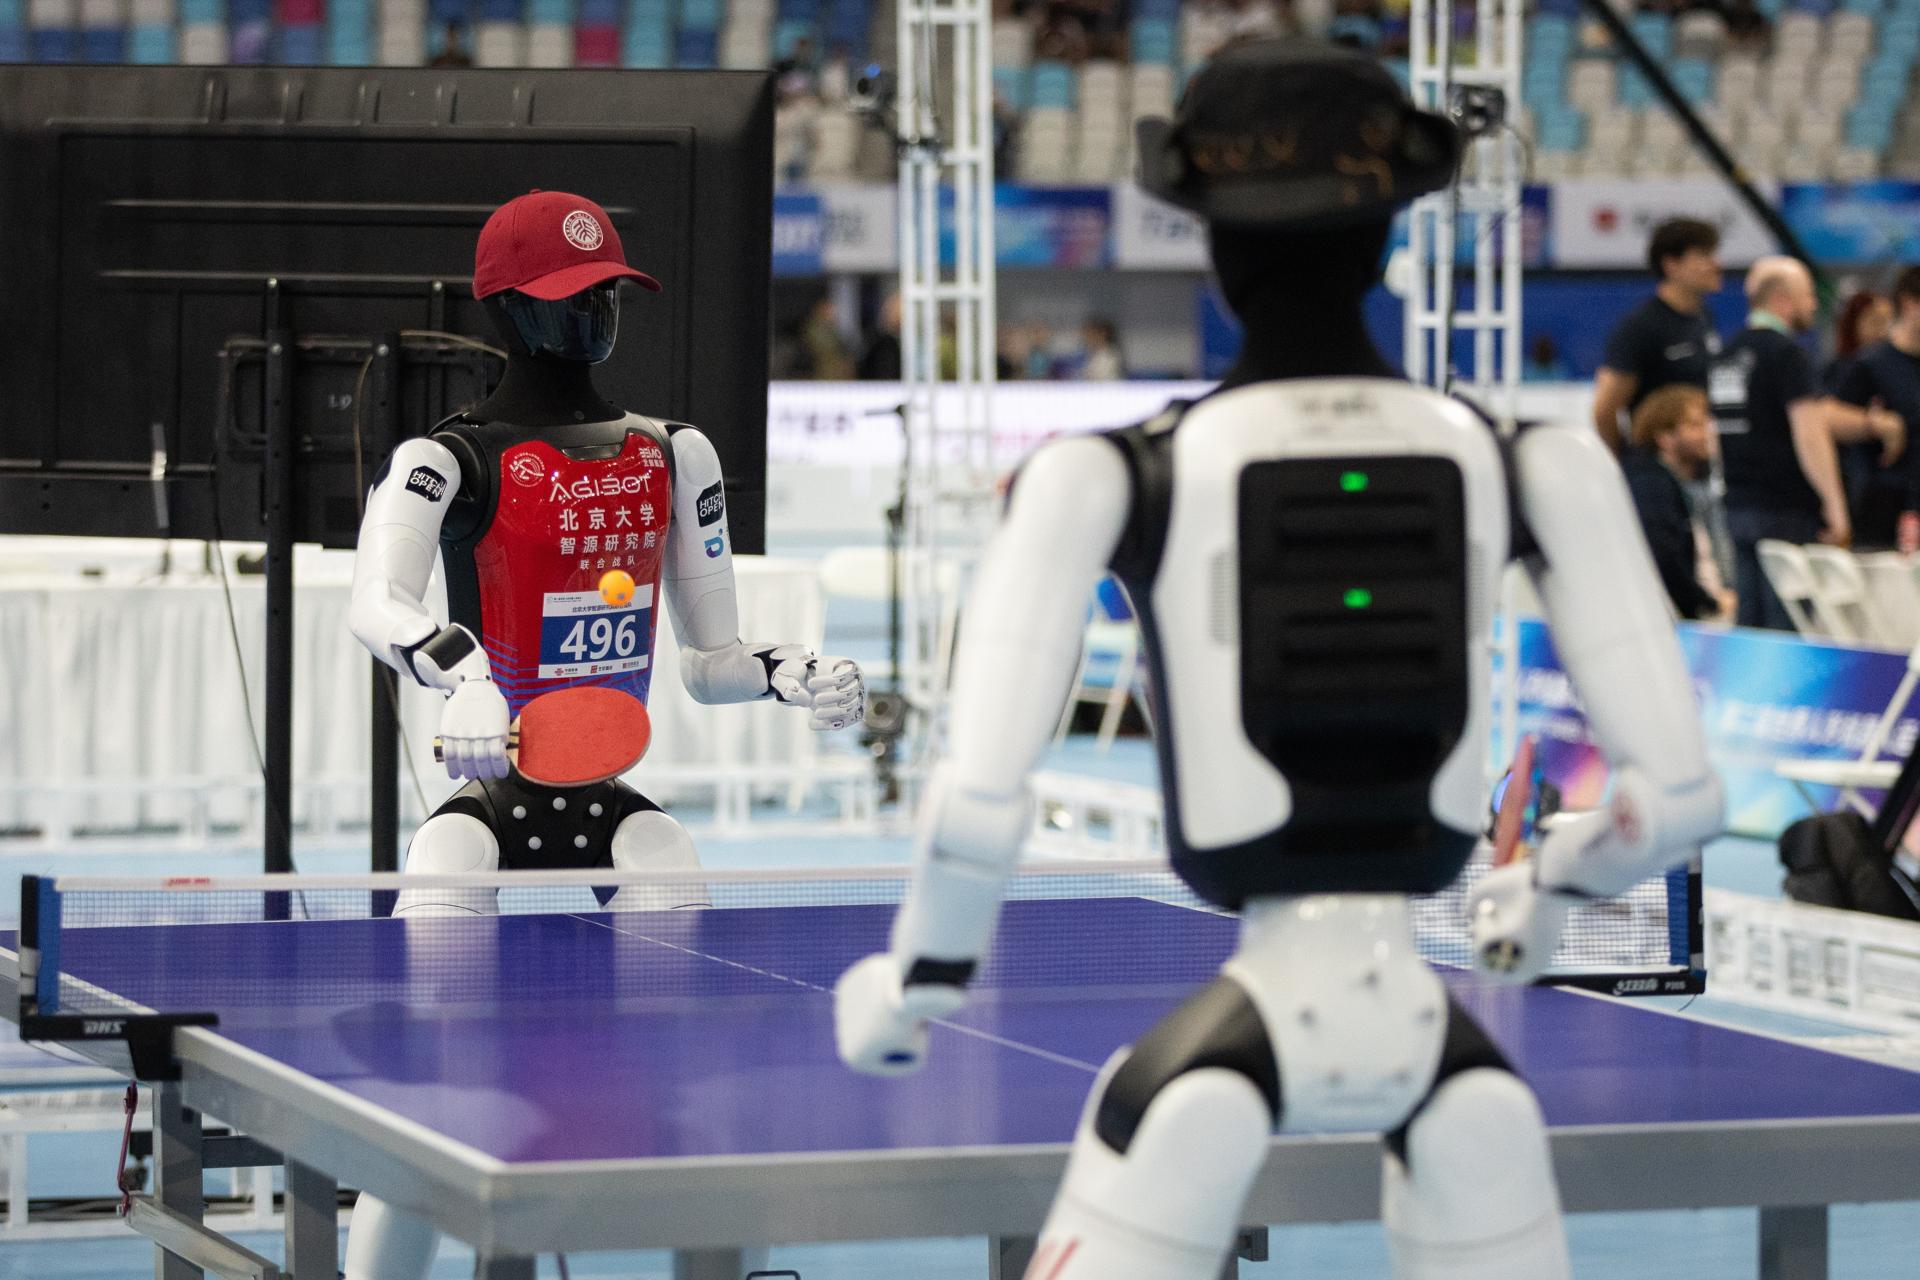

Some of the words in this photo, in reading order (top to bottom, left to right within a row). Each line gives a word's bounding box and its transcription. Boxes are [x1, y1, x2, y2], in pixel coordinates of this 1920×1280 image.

[410, 477, 442, 498] OPEN
[549, 475, 651, 502] AGIBOT
[559, 503, 656, 532] 北京大学
[700, 501, 722, 518] OPEN
[559, 531, 656, 556] 智源研究院
[580, 554, 635, 570] 联合战队
[560, 614, 636, 661] 496
